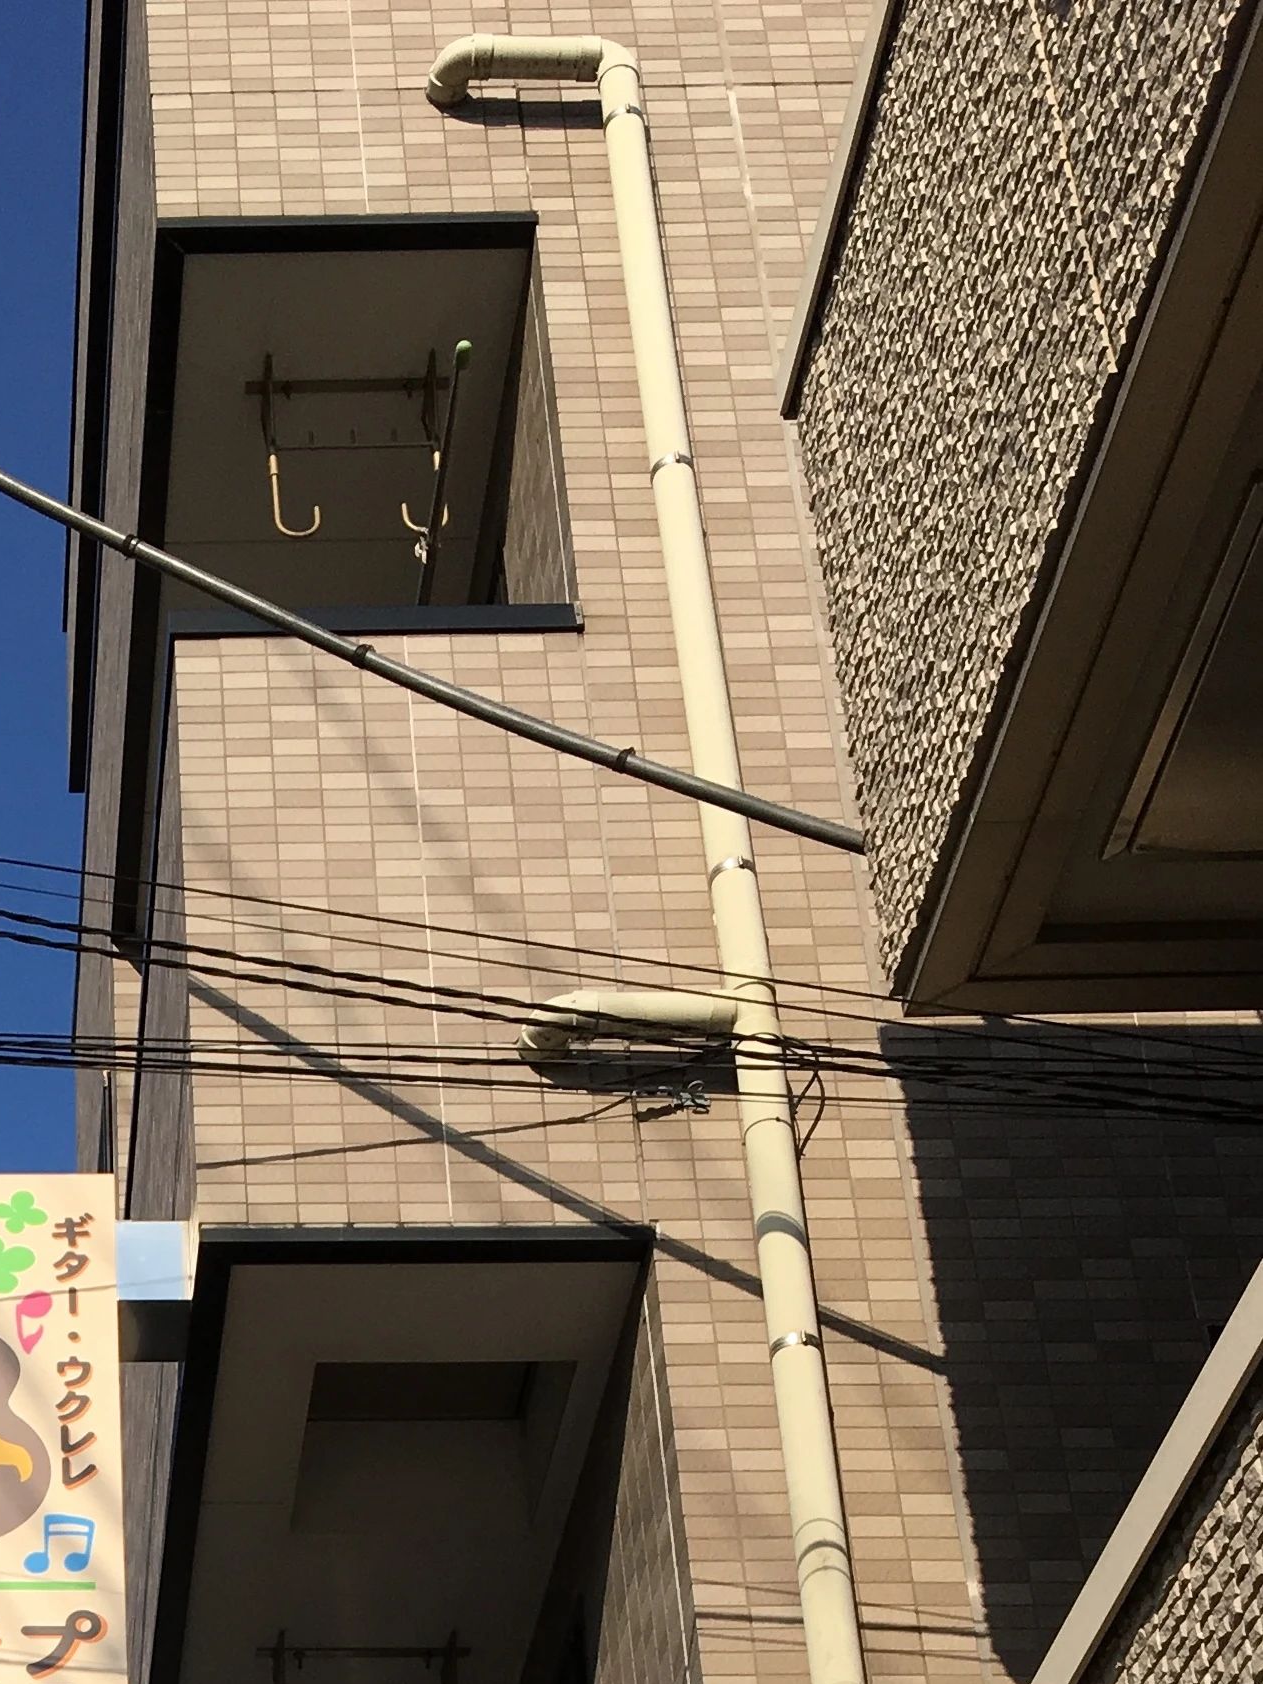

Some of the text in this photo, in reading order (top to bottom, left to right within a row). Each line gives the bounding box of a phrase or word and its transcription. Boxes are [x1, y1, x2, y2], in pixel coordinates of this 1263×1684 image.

[52, 1212, 98, 1490] ギター・ウクレレ
